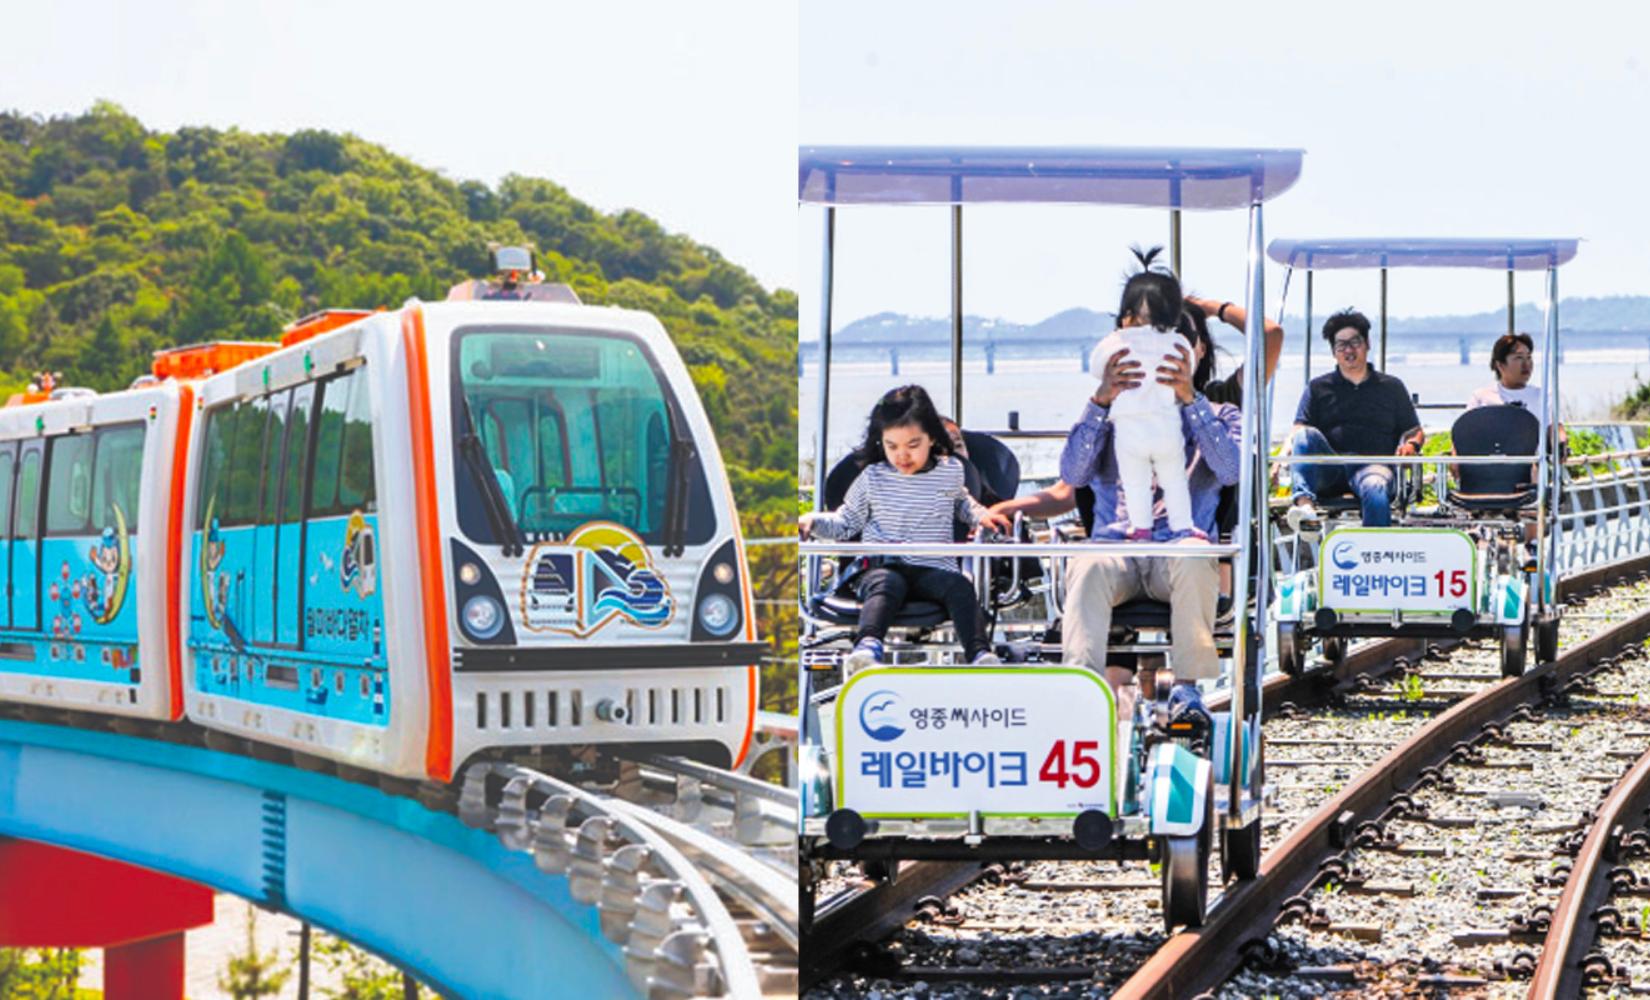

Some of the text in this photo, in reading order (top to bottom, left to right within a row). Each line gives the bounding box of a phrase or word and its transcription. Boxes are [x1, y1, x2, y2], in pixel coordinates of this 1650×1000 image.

[1361, 550, 1427, 563] 영종씨사이드
[1332, 569, 1468, 598] 레일바이크 15
[909, 707, 1028, 730] 영종씨사이드
[860, 739, 1101, 789] 레일바이크 45
